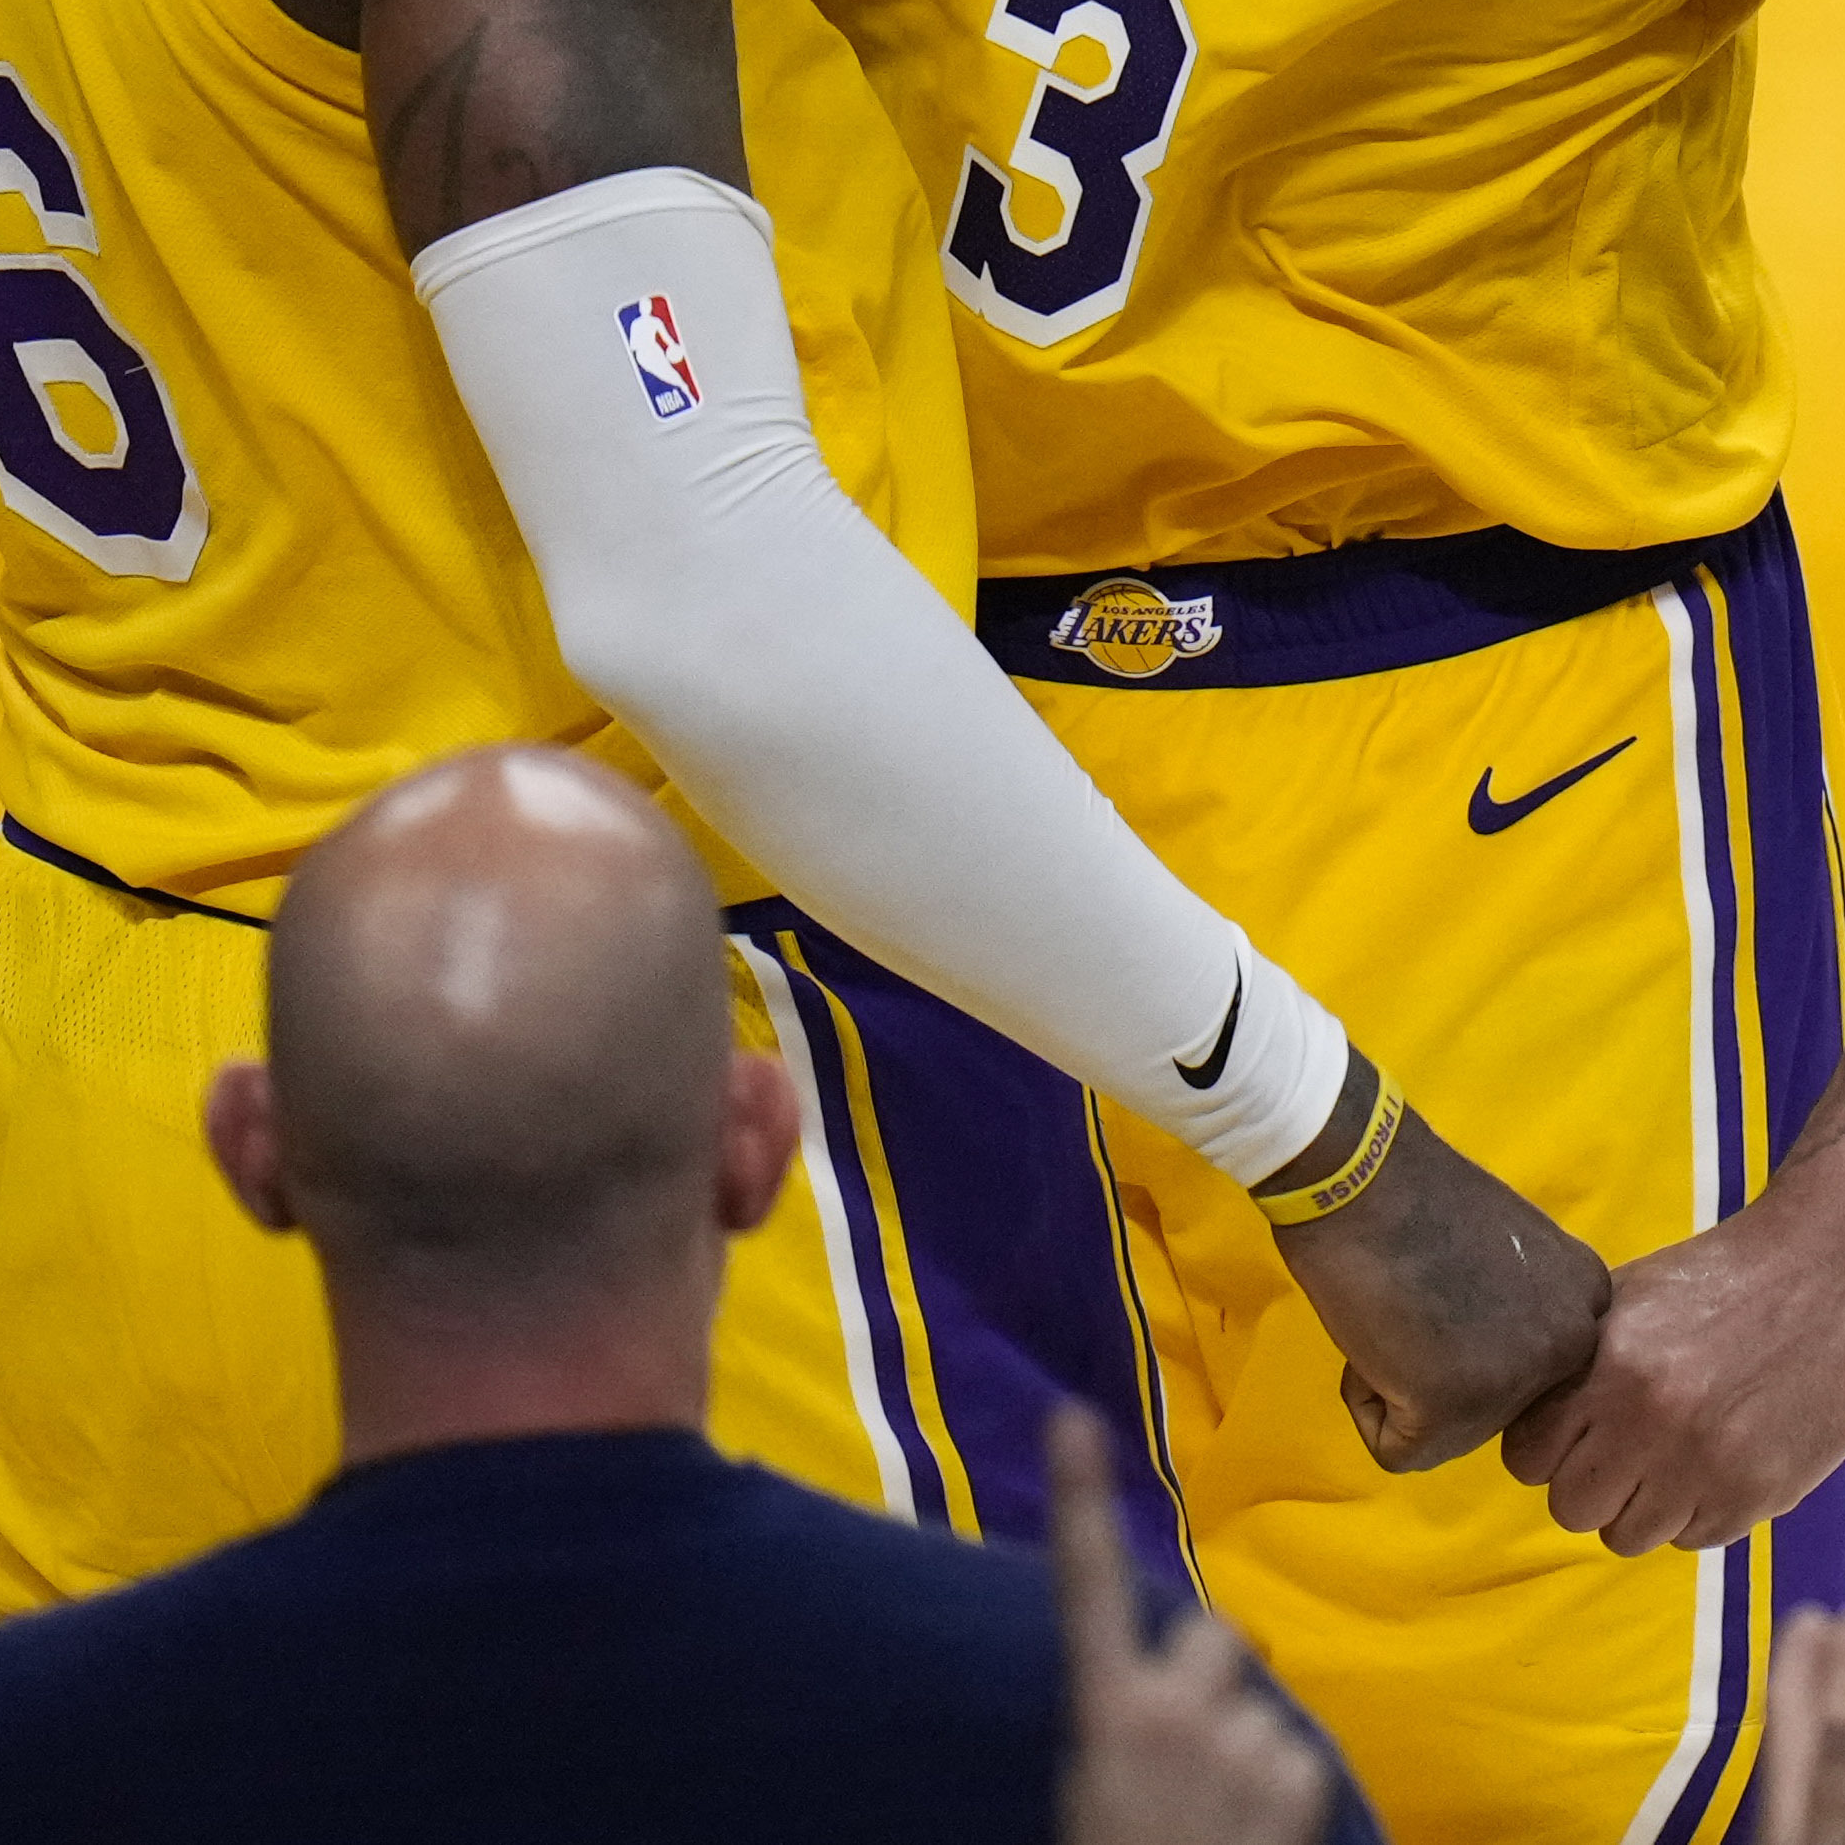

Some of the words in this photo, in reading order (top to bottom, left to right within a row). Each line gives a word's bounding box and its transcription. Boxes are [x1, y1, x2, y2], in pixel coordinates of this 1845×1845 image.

[1061, 599, 1215, 653] LAKERS
[1101, 605, 1129, 615] LOS
[1131, 603, 1207, 616] ANGELES
[1311, 1108, 1395, 1211] PROMISE
